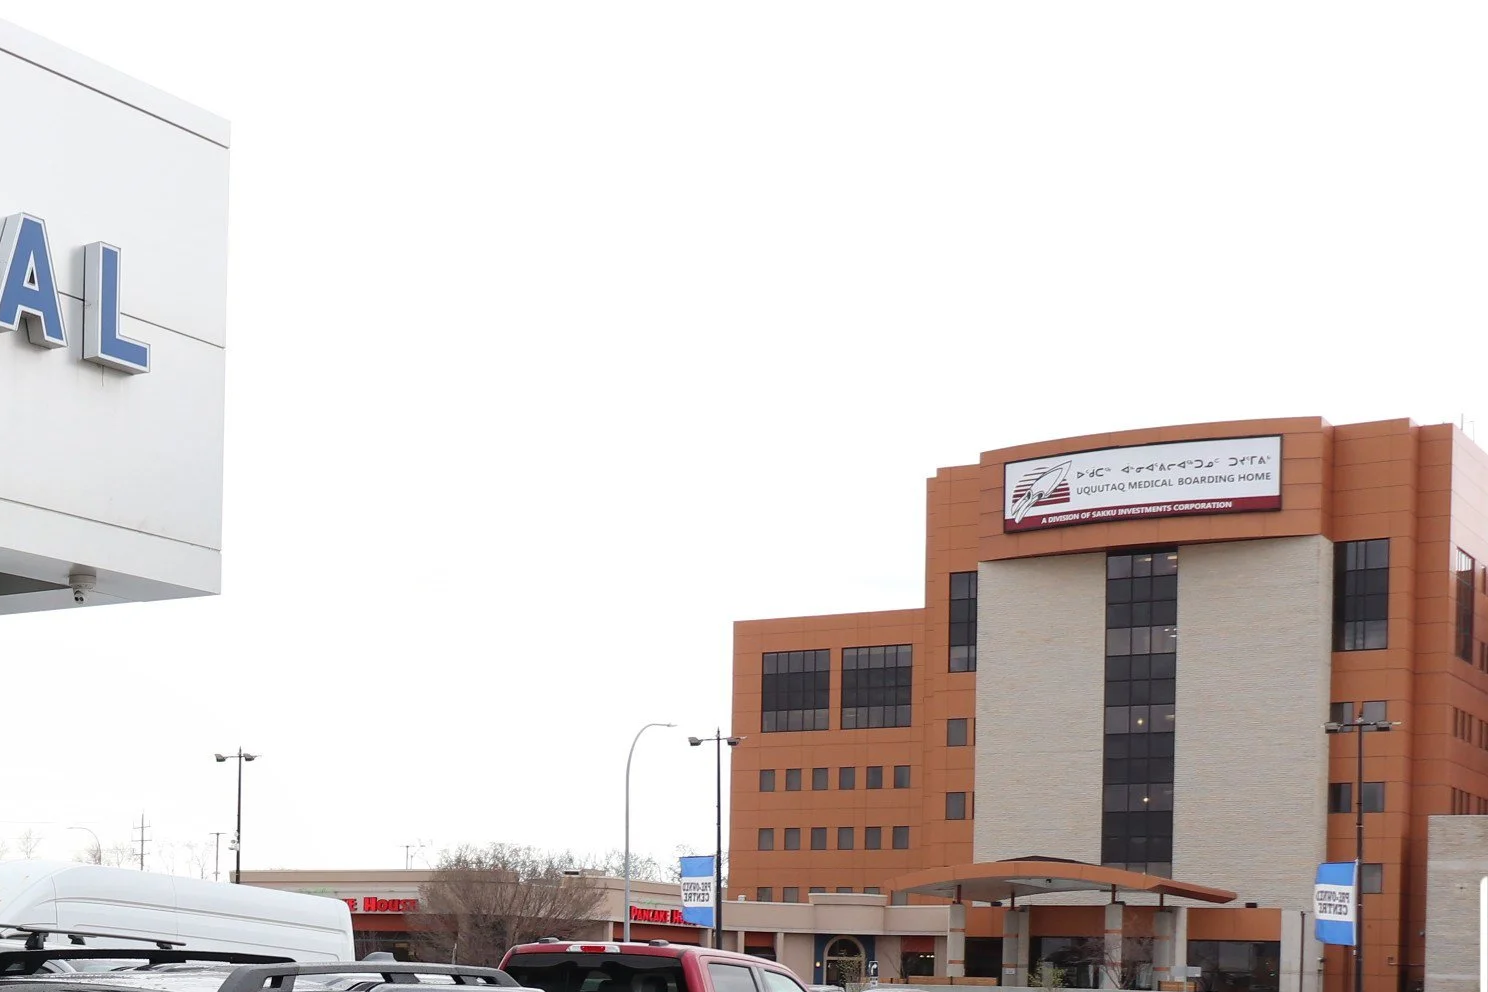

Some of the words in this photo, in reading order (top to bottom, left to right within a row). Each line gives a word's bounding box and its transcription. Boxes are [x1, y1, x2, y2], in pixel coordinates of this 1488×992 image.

[1076, 481, 1126, 495] UQUUTAQ
[1128, 479, 1174, 490] MEDICAL
[1178, 475, 1235, 486] BOARDING
[1238, 472, 1271, 482] HOME
[1041, 517, 1047, 525] A
[1048, 513, 1080, 524] DIVISION
[1092, 509, 1118, 518] SAKKU
[1118, 504, 1172, 516] INVESTMENTS
[1173, 501, 1233, 511] CORPORATION
